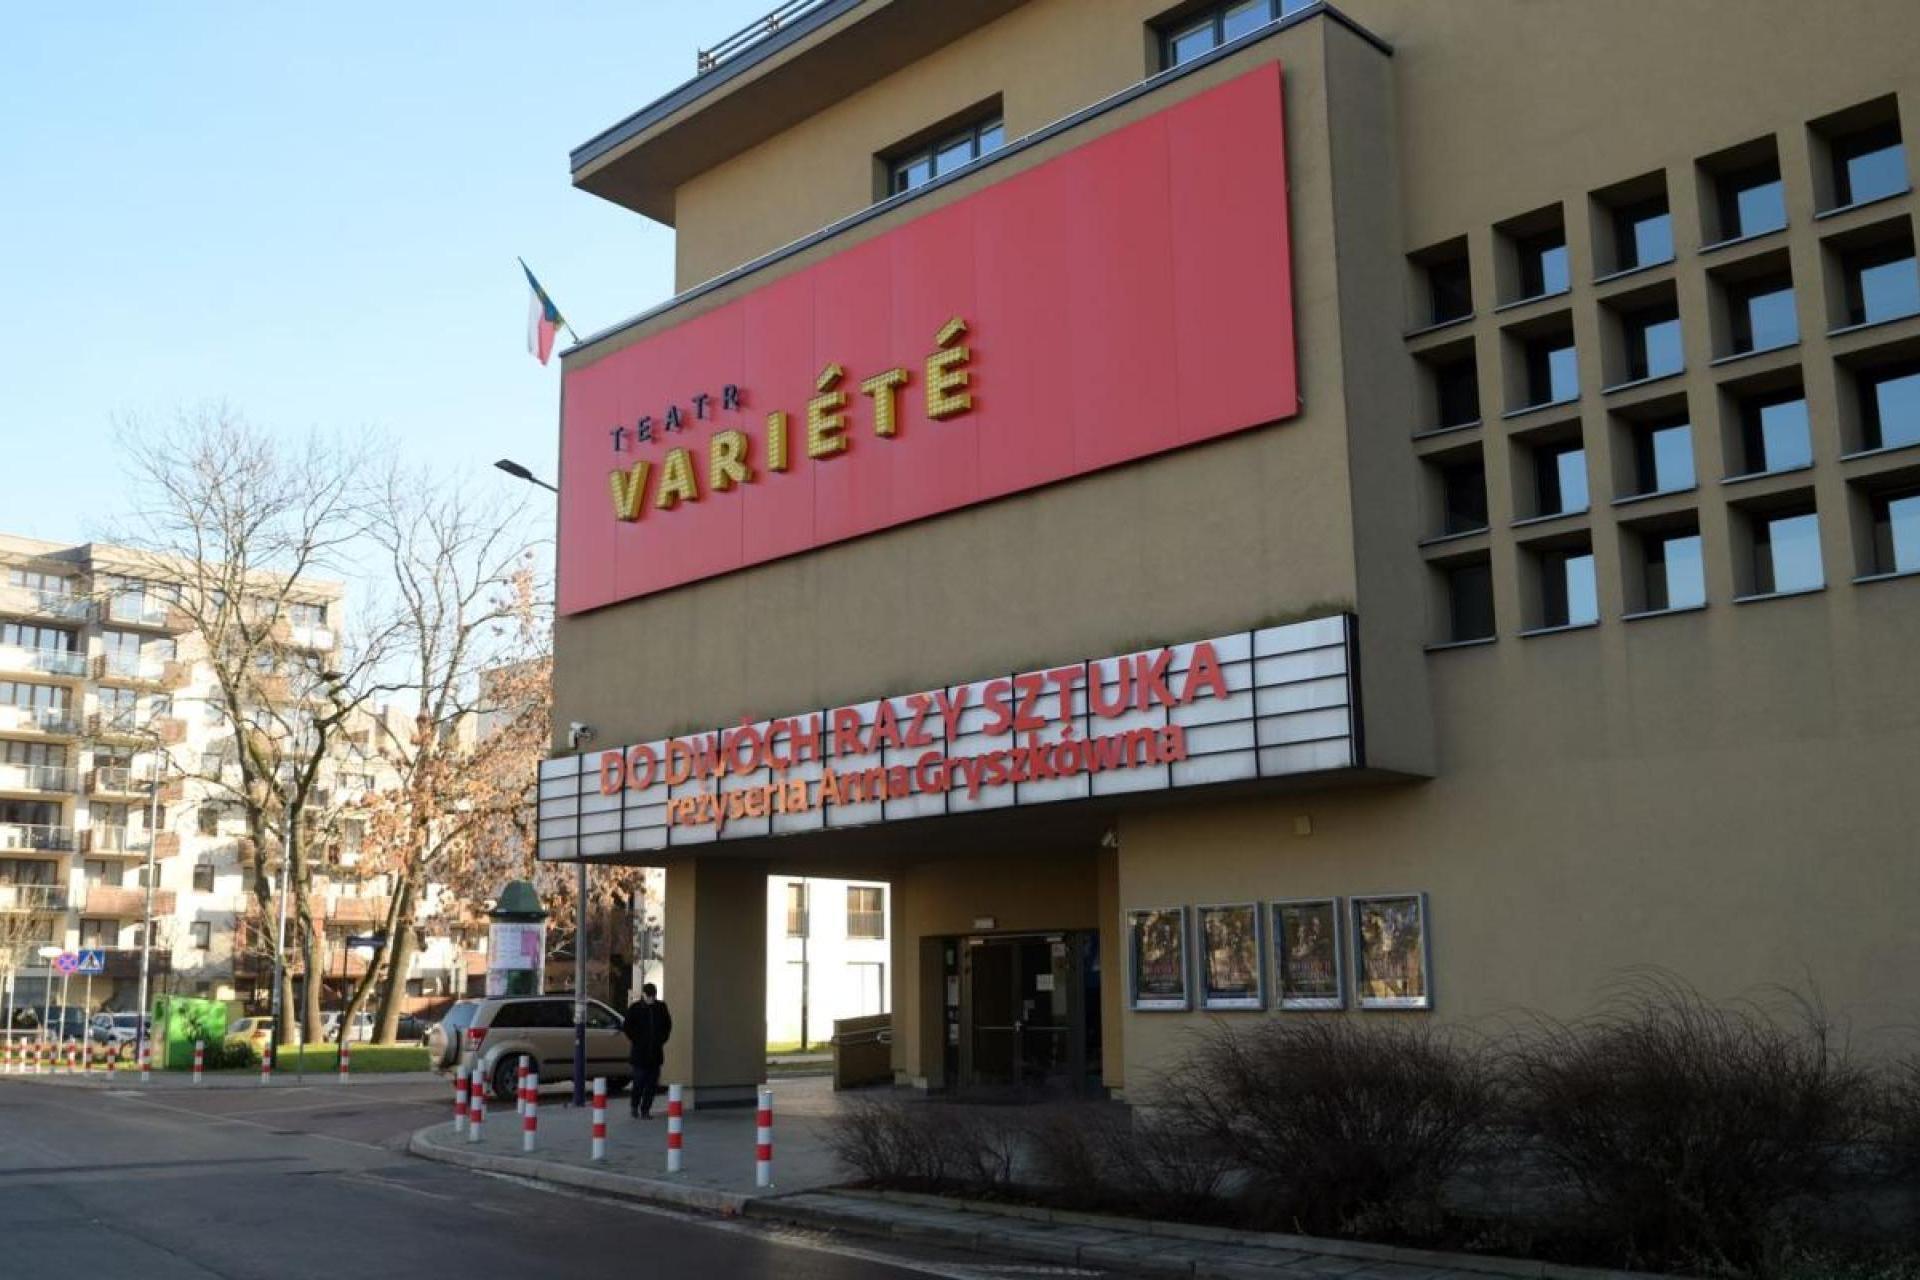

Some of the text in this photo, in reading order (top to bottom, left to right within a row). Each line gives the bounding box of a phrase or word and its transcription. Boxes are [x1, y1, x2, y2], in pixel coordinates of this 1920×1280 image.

[609, 383, 742, 451] TEATR
[609, 318, 972, 522] VARIÉTÉ
[600, 641, 1228, 795] DO DWÓCH RAZY SZTUKA
[666, 723, 1188, 831] reżyseria Anna Gryszkówna
